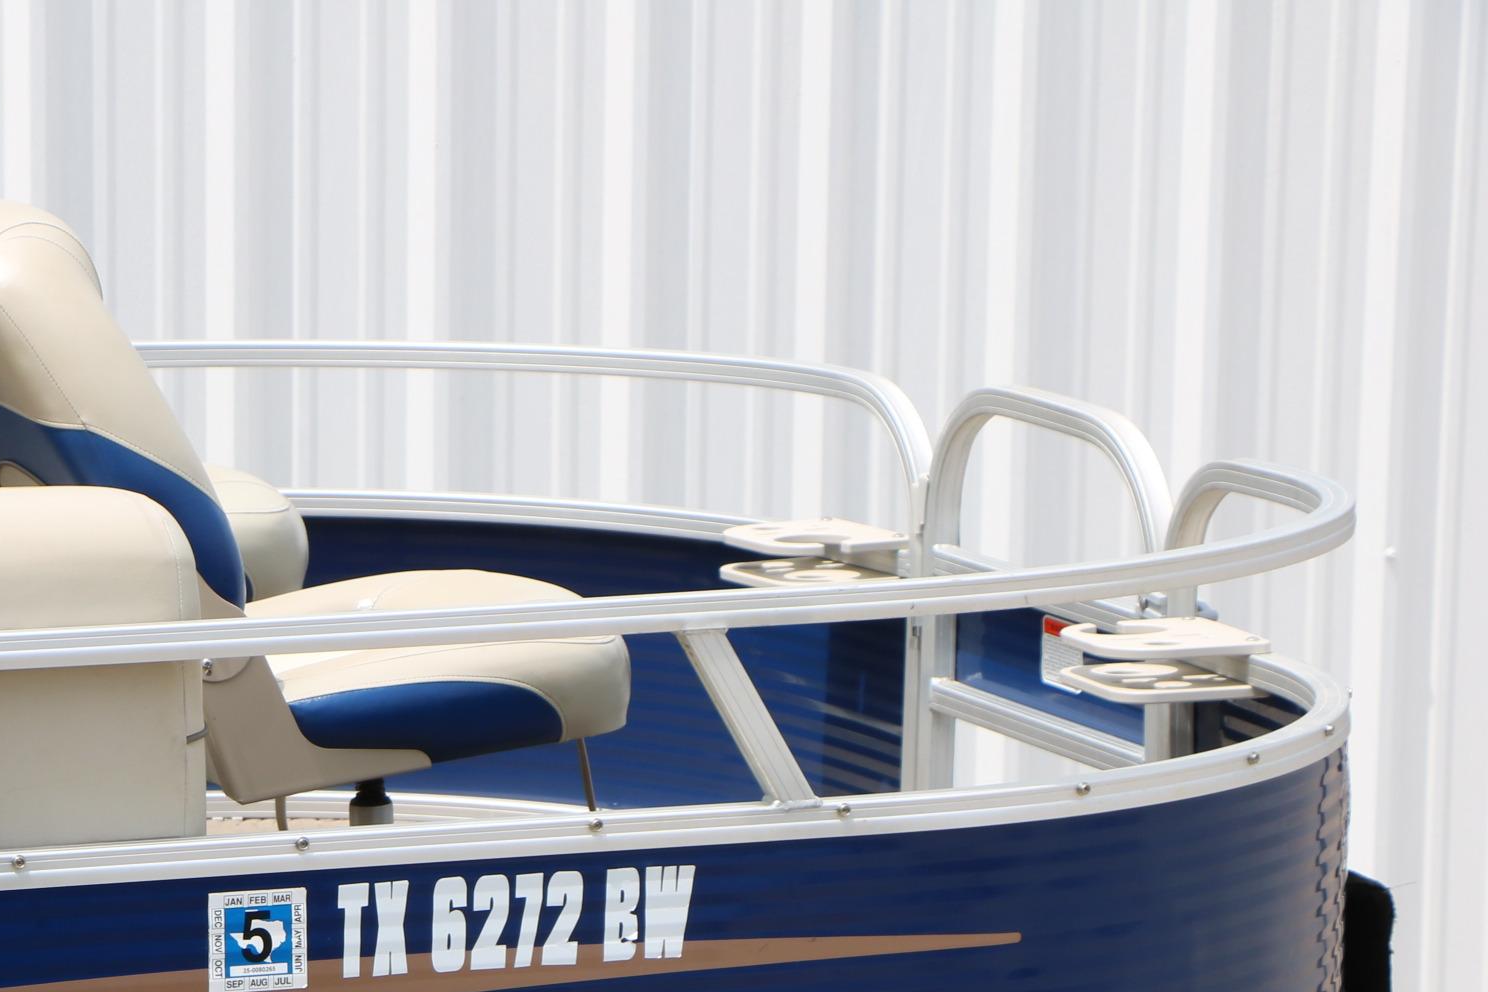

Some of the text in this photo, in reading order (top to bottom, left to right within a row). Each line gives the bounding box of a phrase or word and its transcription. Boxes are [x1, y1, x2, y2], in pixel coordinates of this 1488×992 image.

[225, 894, 291, 906] JAN FEB MAR
[214, 909, 222, 928] DEC
[293, 904, 302, 923] APR
[338, 865, 696, 978] TX 6272 BW
[214, 935, 222, 953] NOV
[241, 910, 272, 963] 5
[294, 930, 302, 948] MAY
[215, 960, 223, 978] OCT
[294, 955, 303, 972] JUN
[226, 977, 291, 989] SEP AUG JUL
